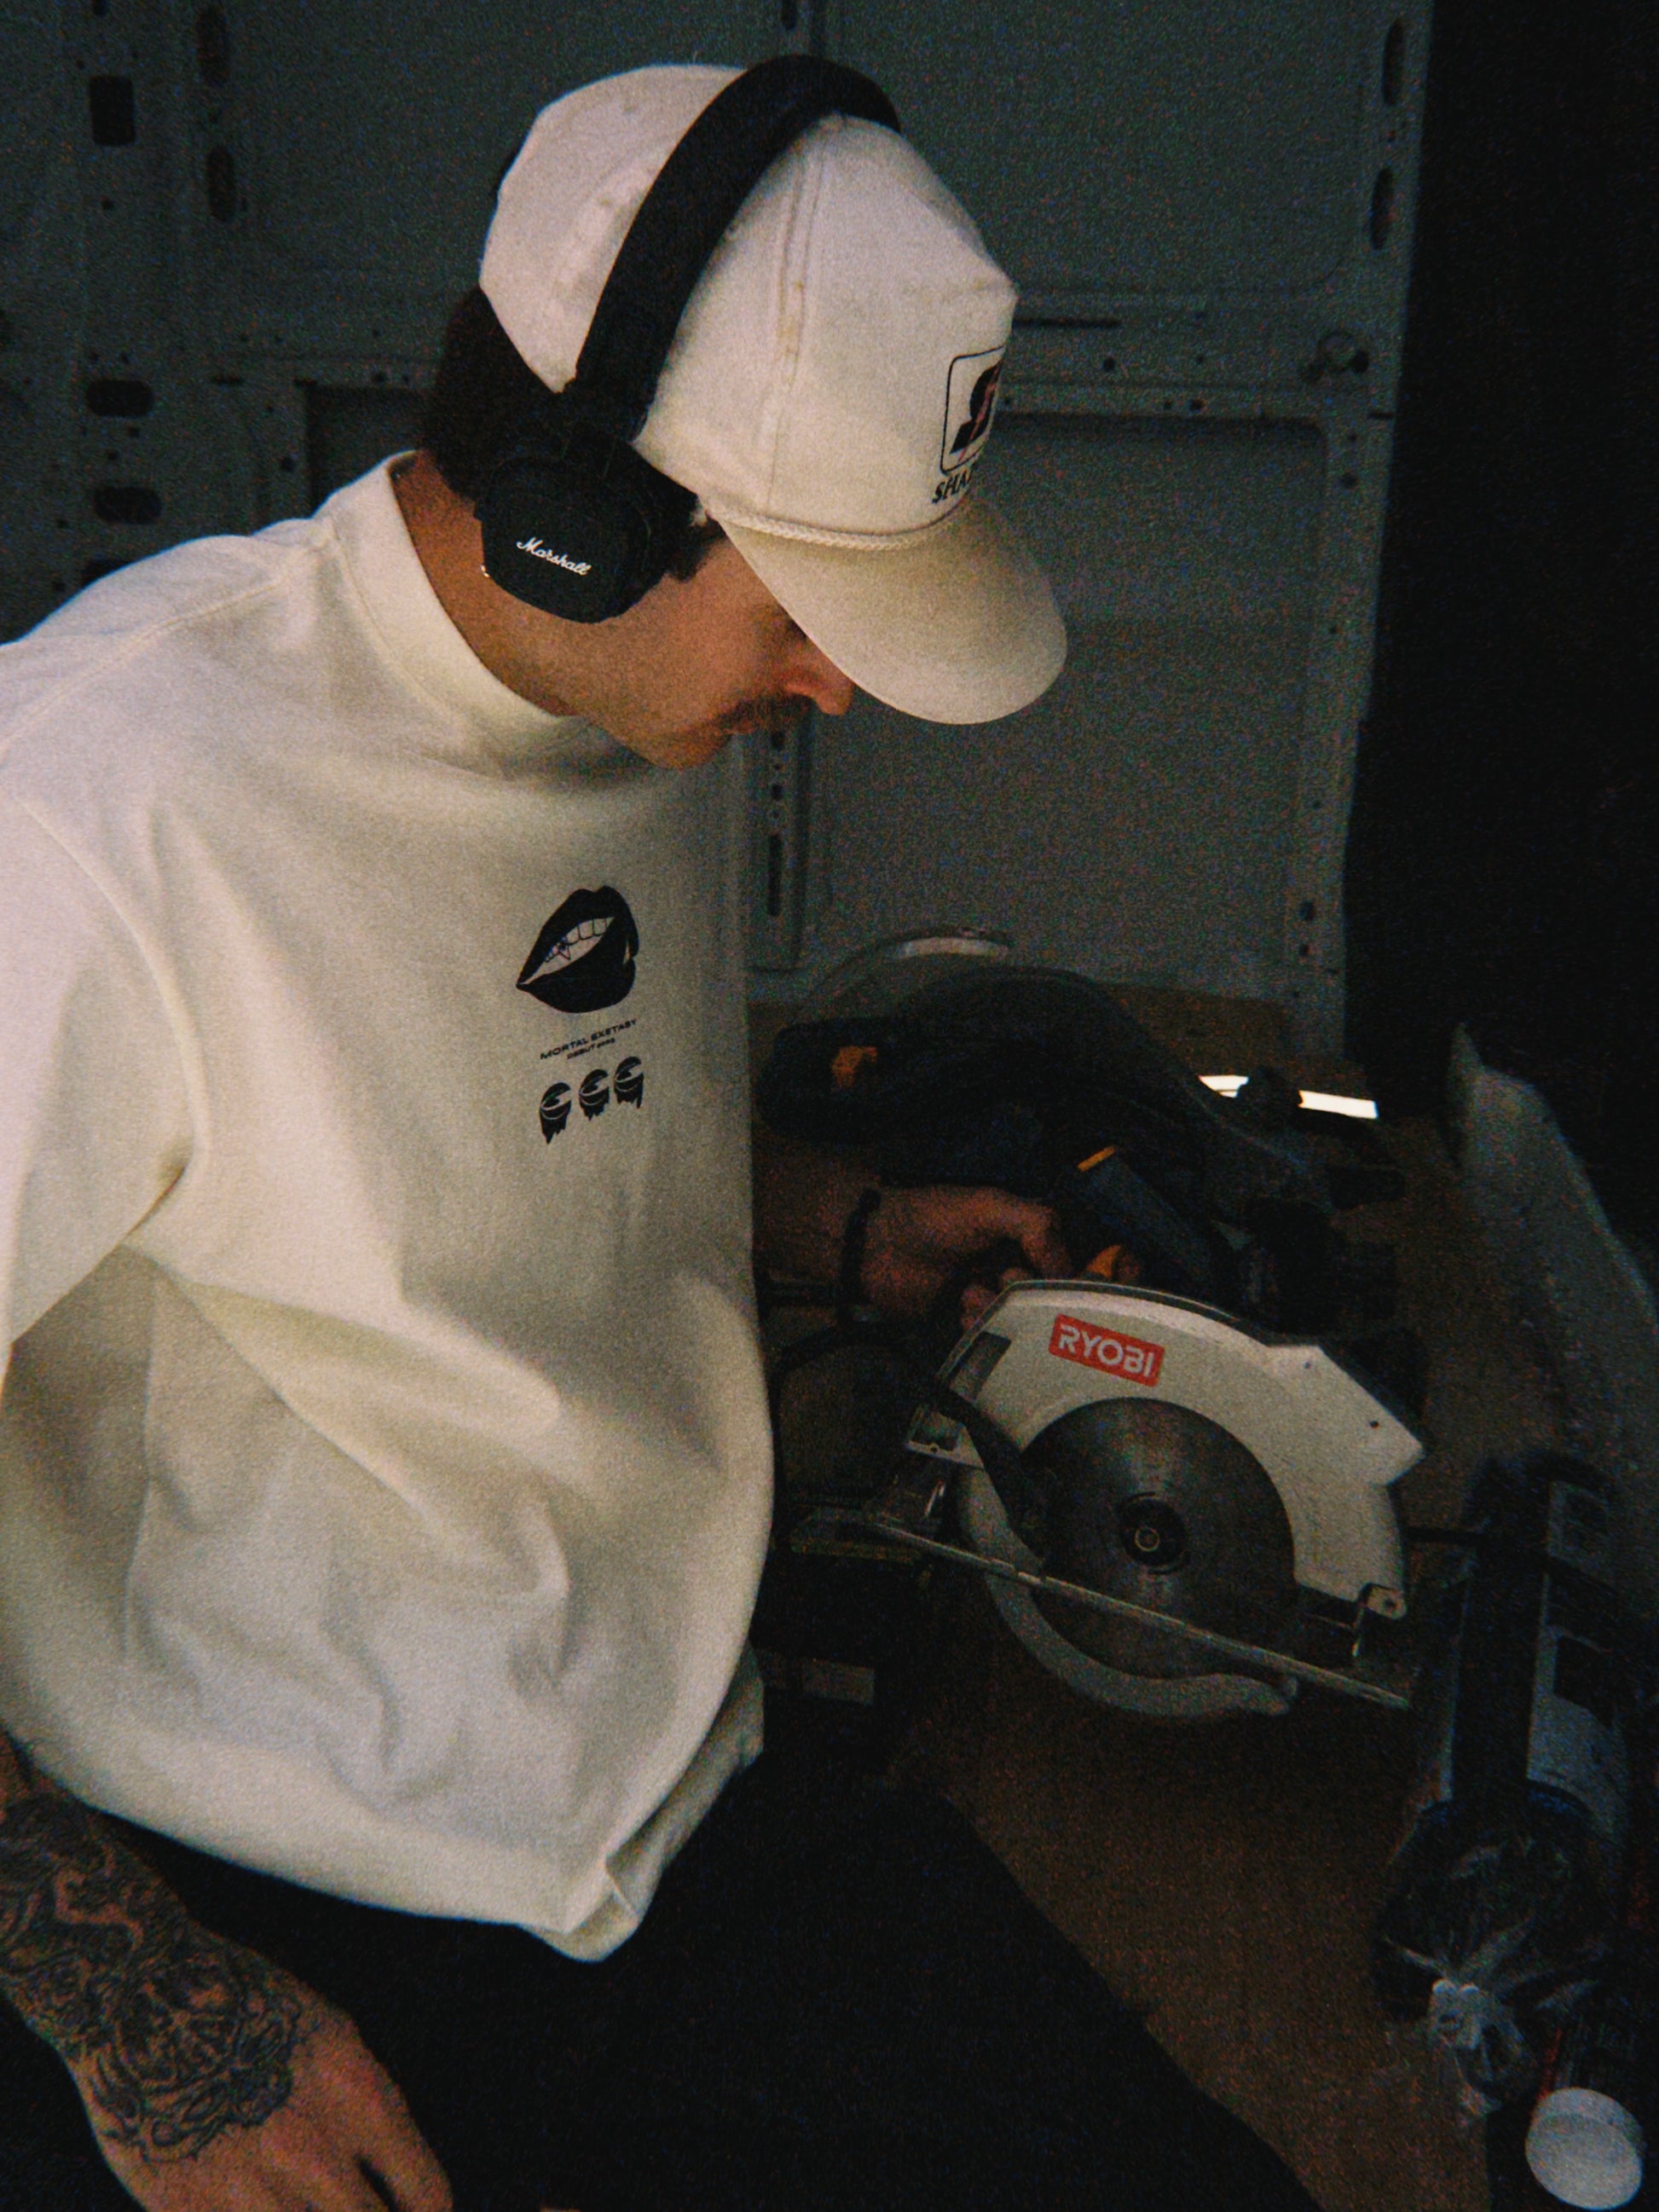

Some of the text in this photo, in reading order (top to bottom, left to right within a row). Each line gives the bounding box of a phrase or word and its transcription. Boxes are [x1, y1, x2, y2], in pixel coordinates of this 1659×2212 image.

[932, 469, 973, 504] SHA
[516, 536, 592, 576] Marshall
[540, 1038, 588, 1060] MORTAL
[1058, 1323, 1155, 1377] RYOBI
